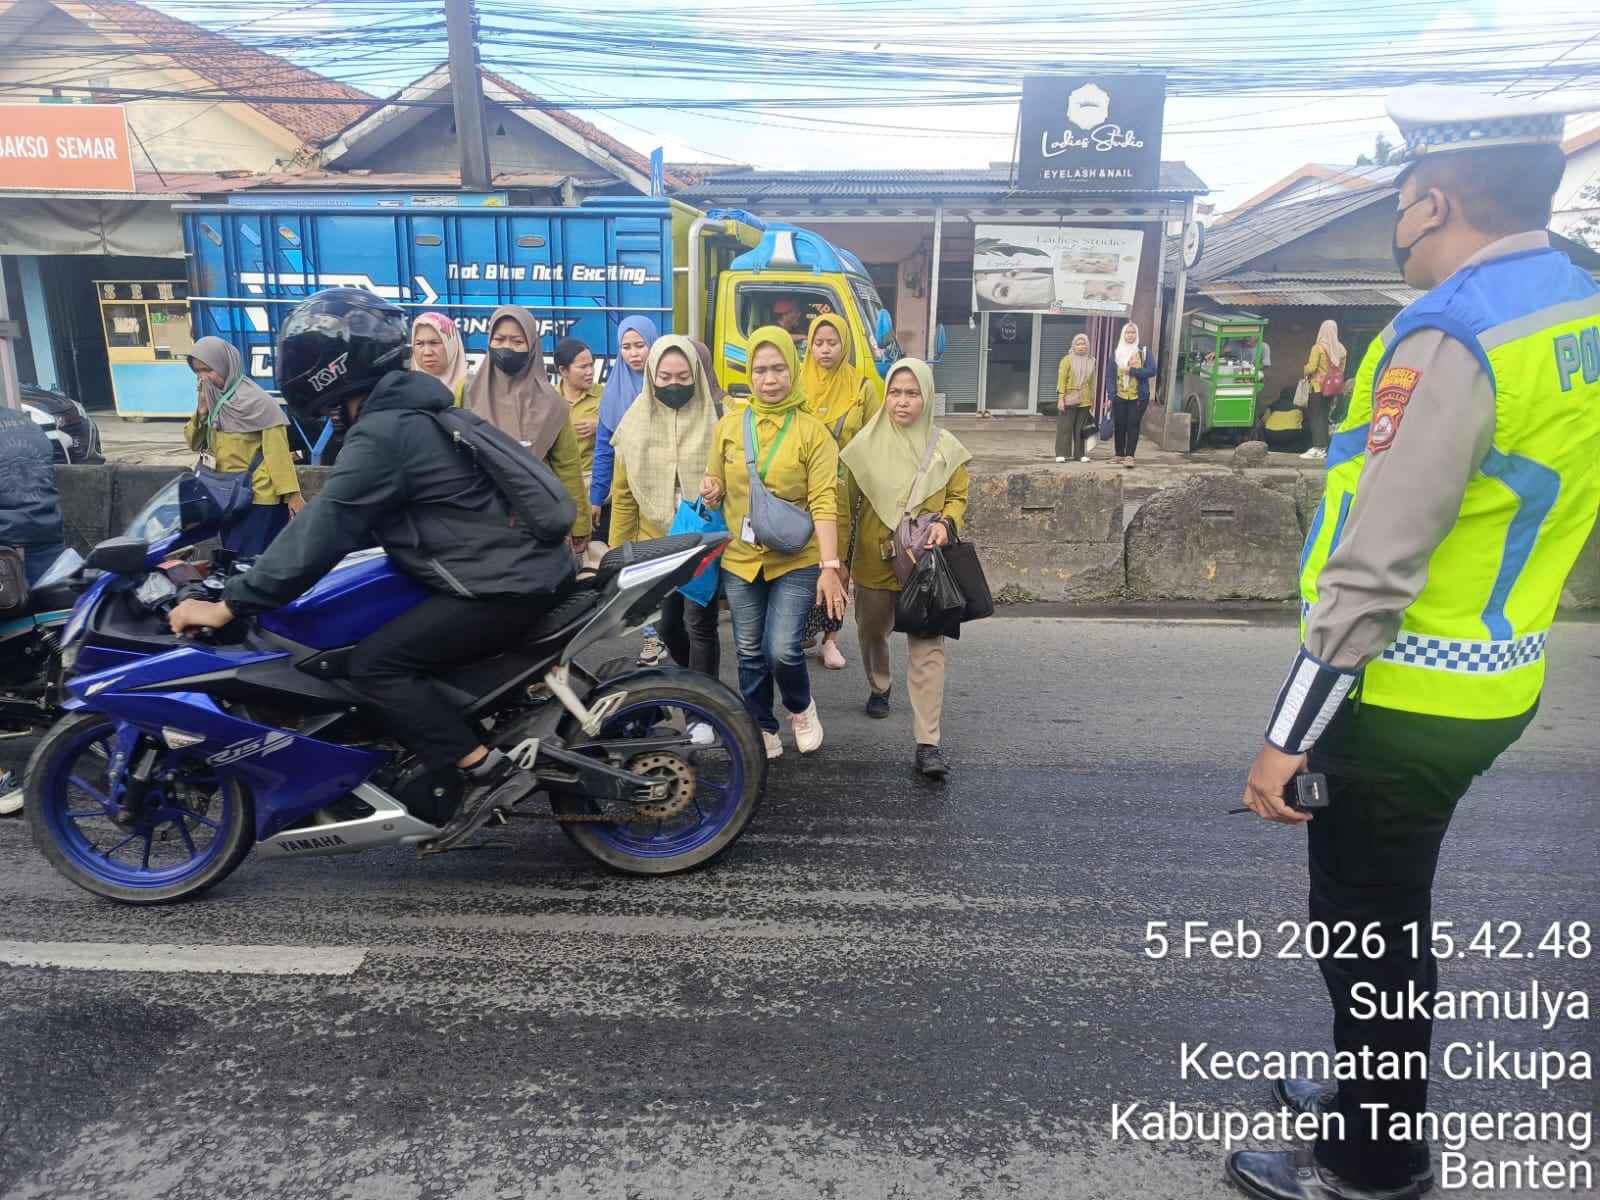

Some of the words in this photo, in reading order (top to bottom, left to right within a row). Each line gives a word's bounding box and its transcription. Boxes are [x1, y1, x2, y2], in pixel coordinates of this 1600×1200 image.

[56, 136, 119, 160] SEMAR
[1041, 129, 1090, 158] Ladies
[1091, 124, 1145, 152] Studio
[1042, 168, 1097, 179] EYELASH
[485, 264, 526, 281] Blue
[532, 264, 564, 281] Not
[307, 352, 349, 392] KYT
[278, 833, 347, 852] YAMAHA
